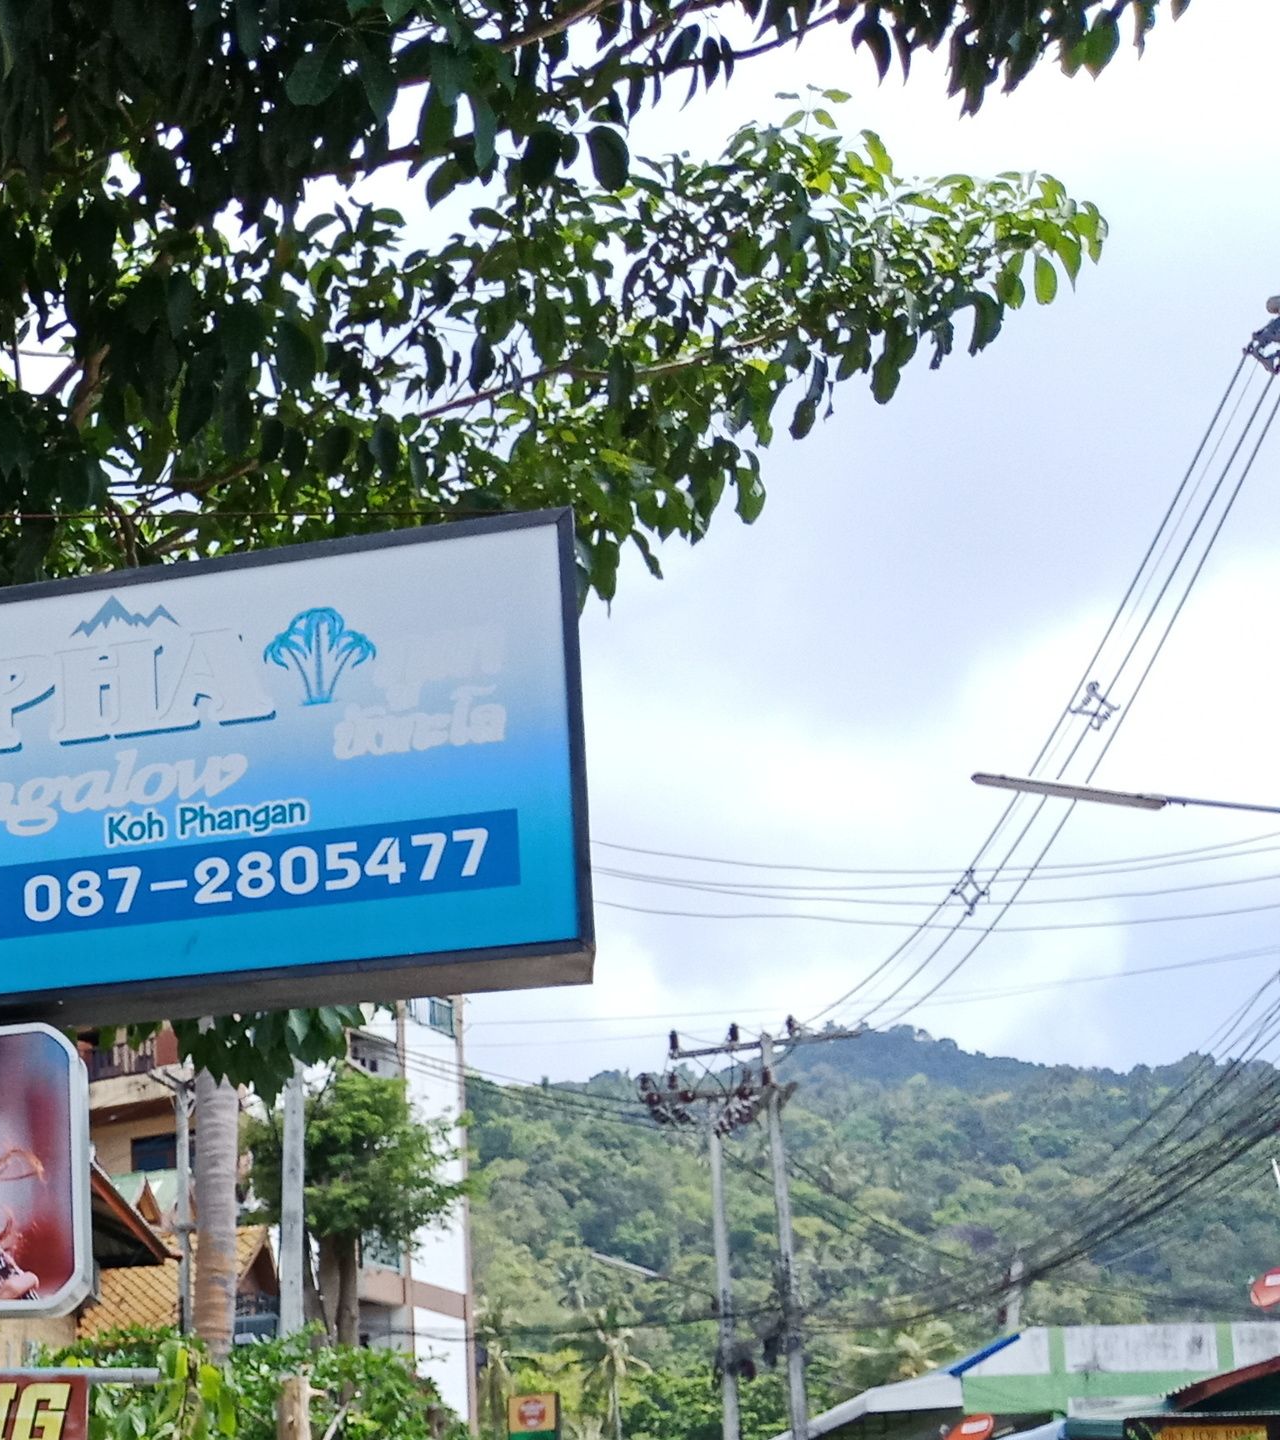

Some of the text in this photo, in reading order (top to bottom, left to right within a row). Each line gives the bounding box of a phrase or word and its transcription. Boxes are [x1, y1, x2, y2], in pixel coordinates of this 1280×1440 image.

[107, 803, 307, 846] Koh Phangan
[23, 827, 490, 924] 087-2805477
